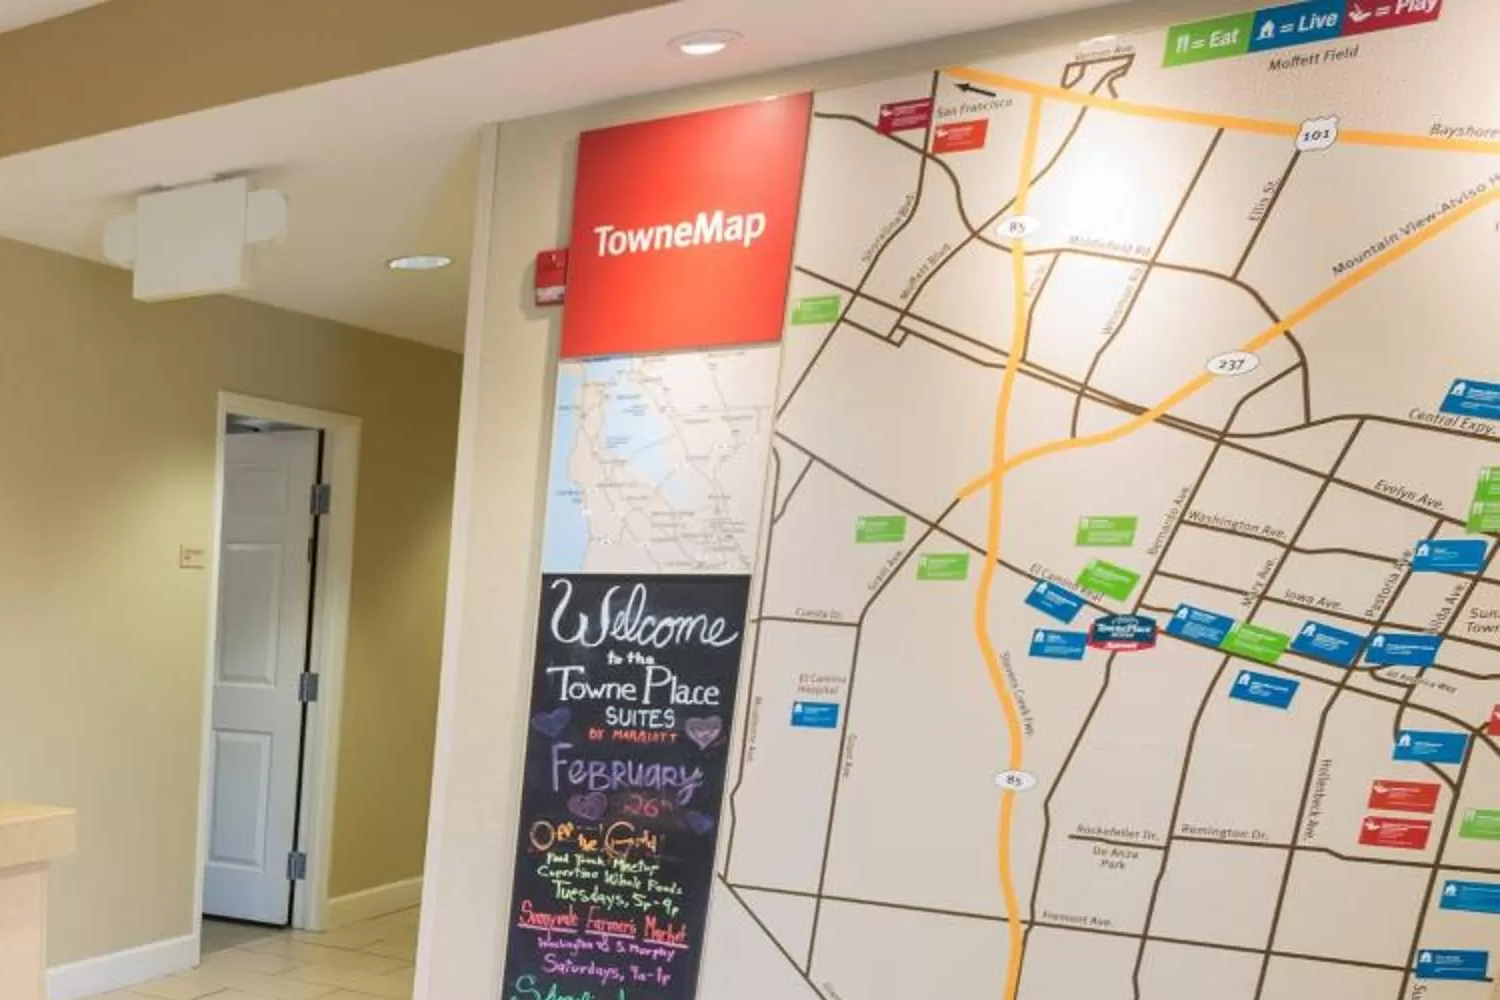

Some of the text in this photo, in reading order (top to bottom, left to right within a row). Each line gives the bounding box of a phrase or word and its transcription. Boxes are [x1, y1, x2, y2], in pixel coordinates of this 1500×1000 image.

[1297, 12, 1338, 32] Live
[1208, 28, 1239, 48] Eat
[1267, 44, 1360, 72] Moffett Field
[937, 104, 957, 118] San
[959, 97, 1013, 116] Francisco
[1303, 128, 1330, 142] 101
[593, 209, 767, 257] TowneMap
[1331, 232, 1399, 276] Mountain
[1217, 358, 1245, 371] 237
[1408, 407, 1459, 429] Central
[1374, 478, 1445, 511] Evelyn Ave.
[1188, 510, 1260, 533] Washington
[1284, 588, 1314, 604] Iowa
[550, 578, 740, 648] Welcome
[607, 650, 655, 665] to the
[546, 665, 720, 705] Towne Place
[605, 705, 676, 729] SUITES
[1006, 775, 1022, 786] 85
[1180, 823, 1249, 840] Remington
[552, 879, 630, 910] Tuesdays,
[543, 953, 626, 986] Saturdays,
